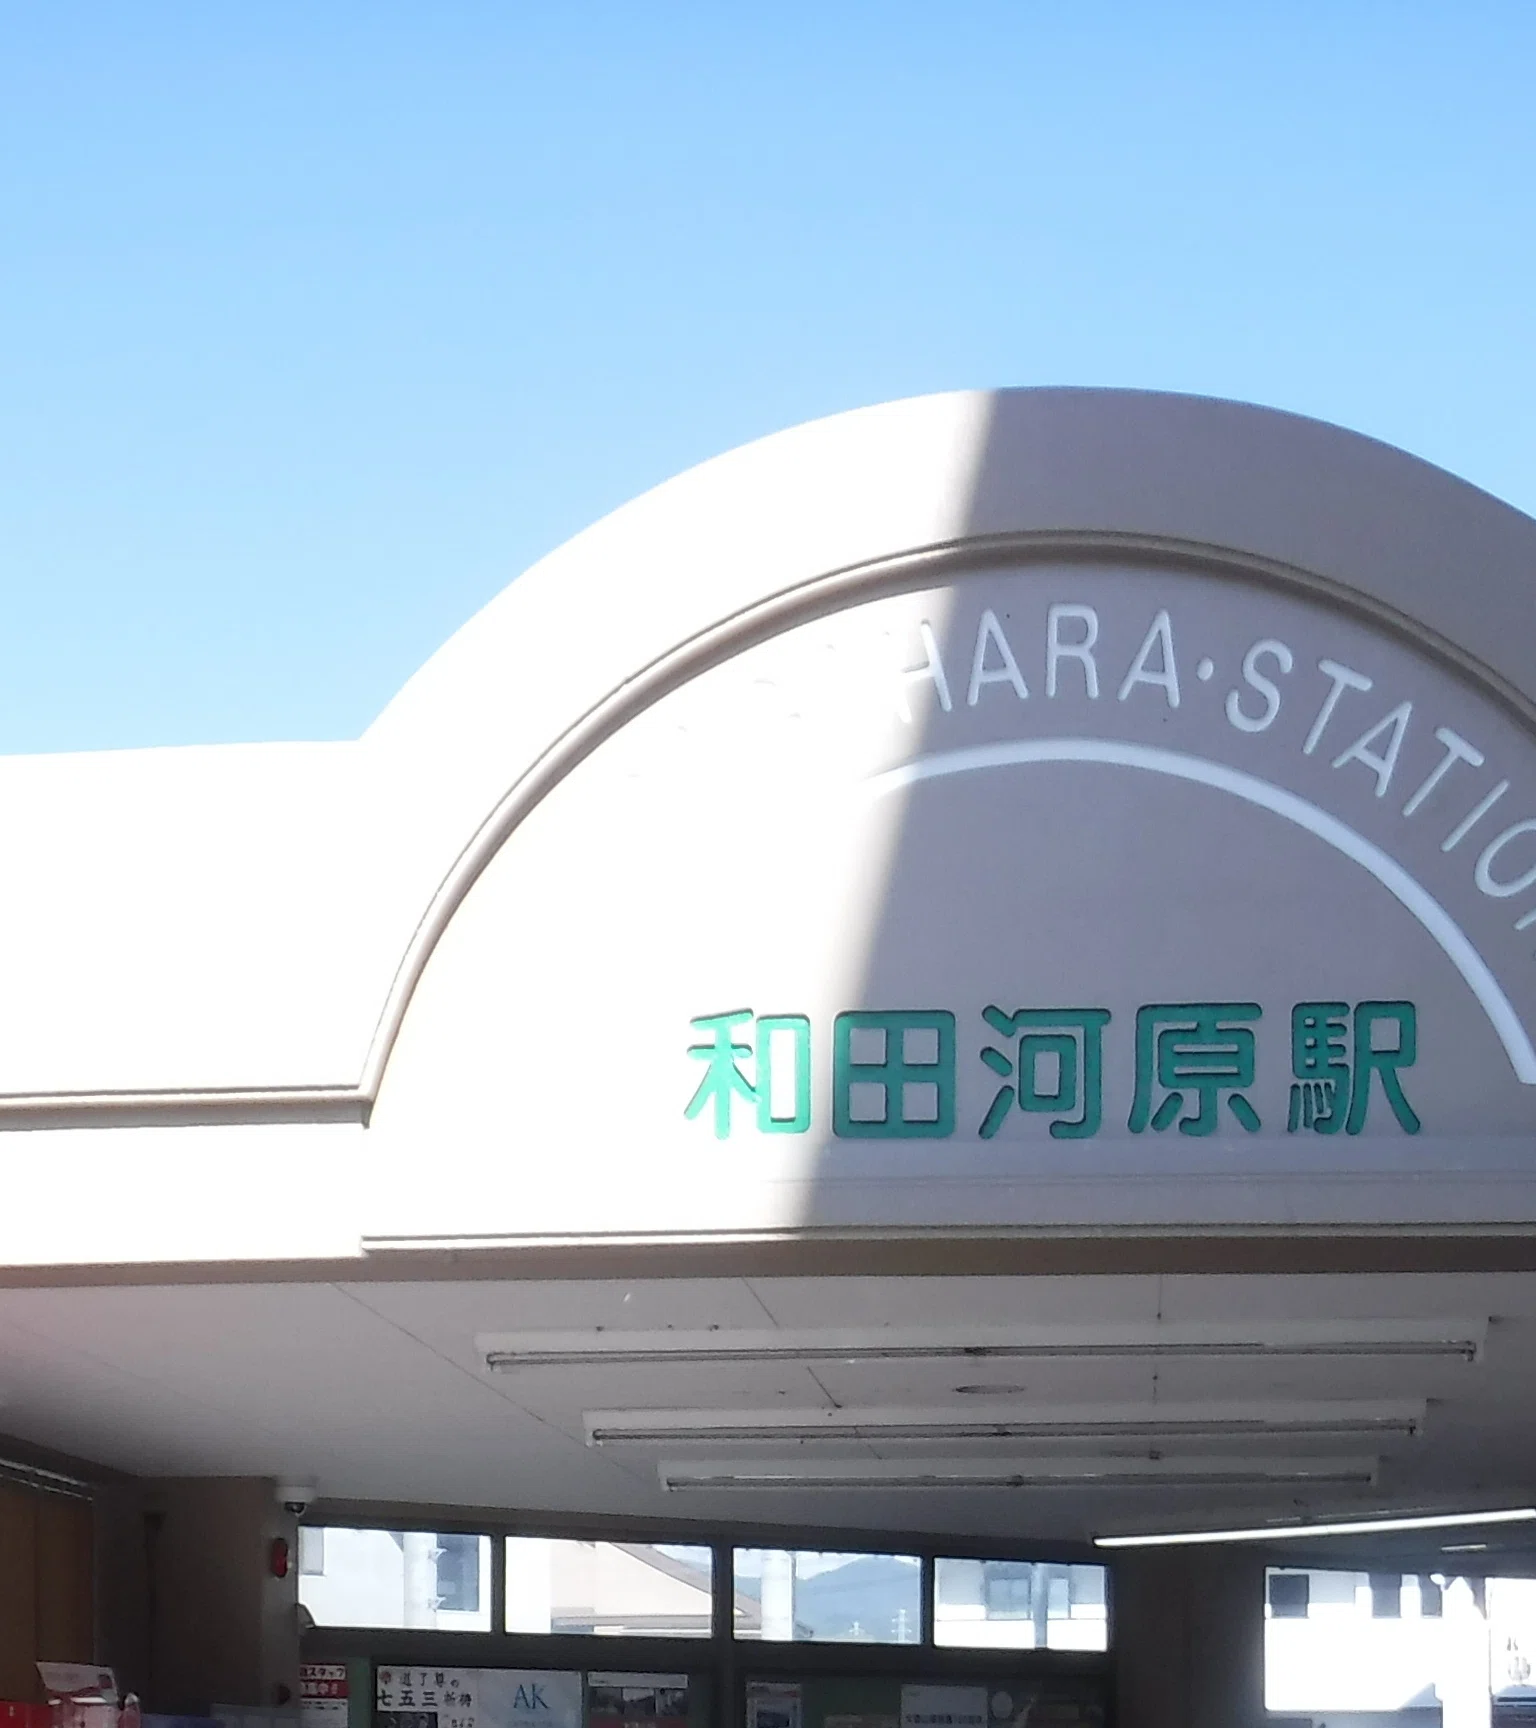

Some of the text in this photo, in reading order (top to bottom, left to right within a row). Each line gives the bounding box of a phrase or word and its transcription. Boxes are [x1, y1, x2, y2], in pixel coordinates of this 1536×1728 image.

[684, 1001, 1421, 1139] 和田河原駅
